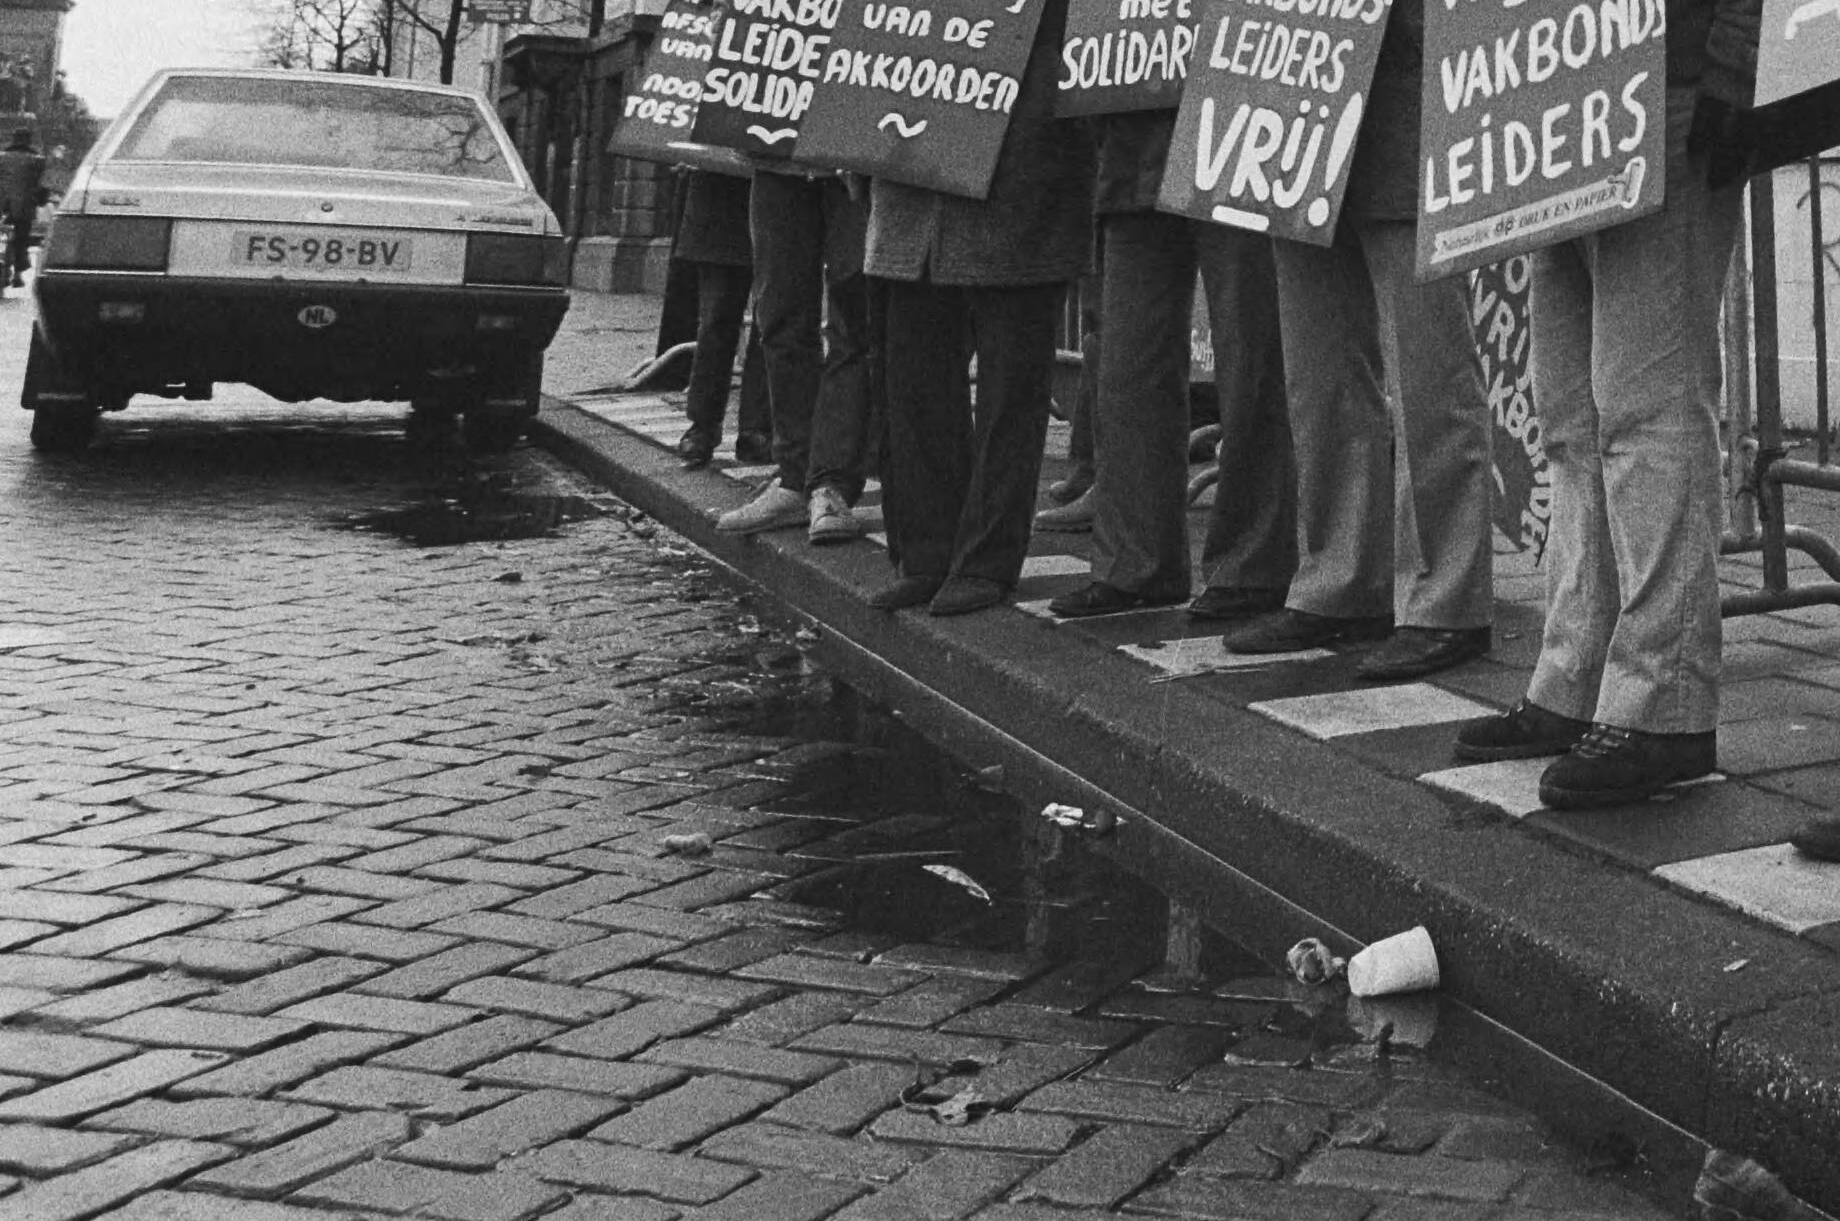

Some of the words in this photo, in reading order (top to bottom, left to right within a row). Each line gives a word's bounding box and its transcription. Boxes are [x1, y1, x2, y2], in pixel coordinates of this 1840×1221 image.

[624, 95, 699, 129] TOES
[247, 236, 400, 266] FS-98-BV
[304, 308, 330, 324] NL
